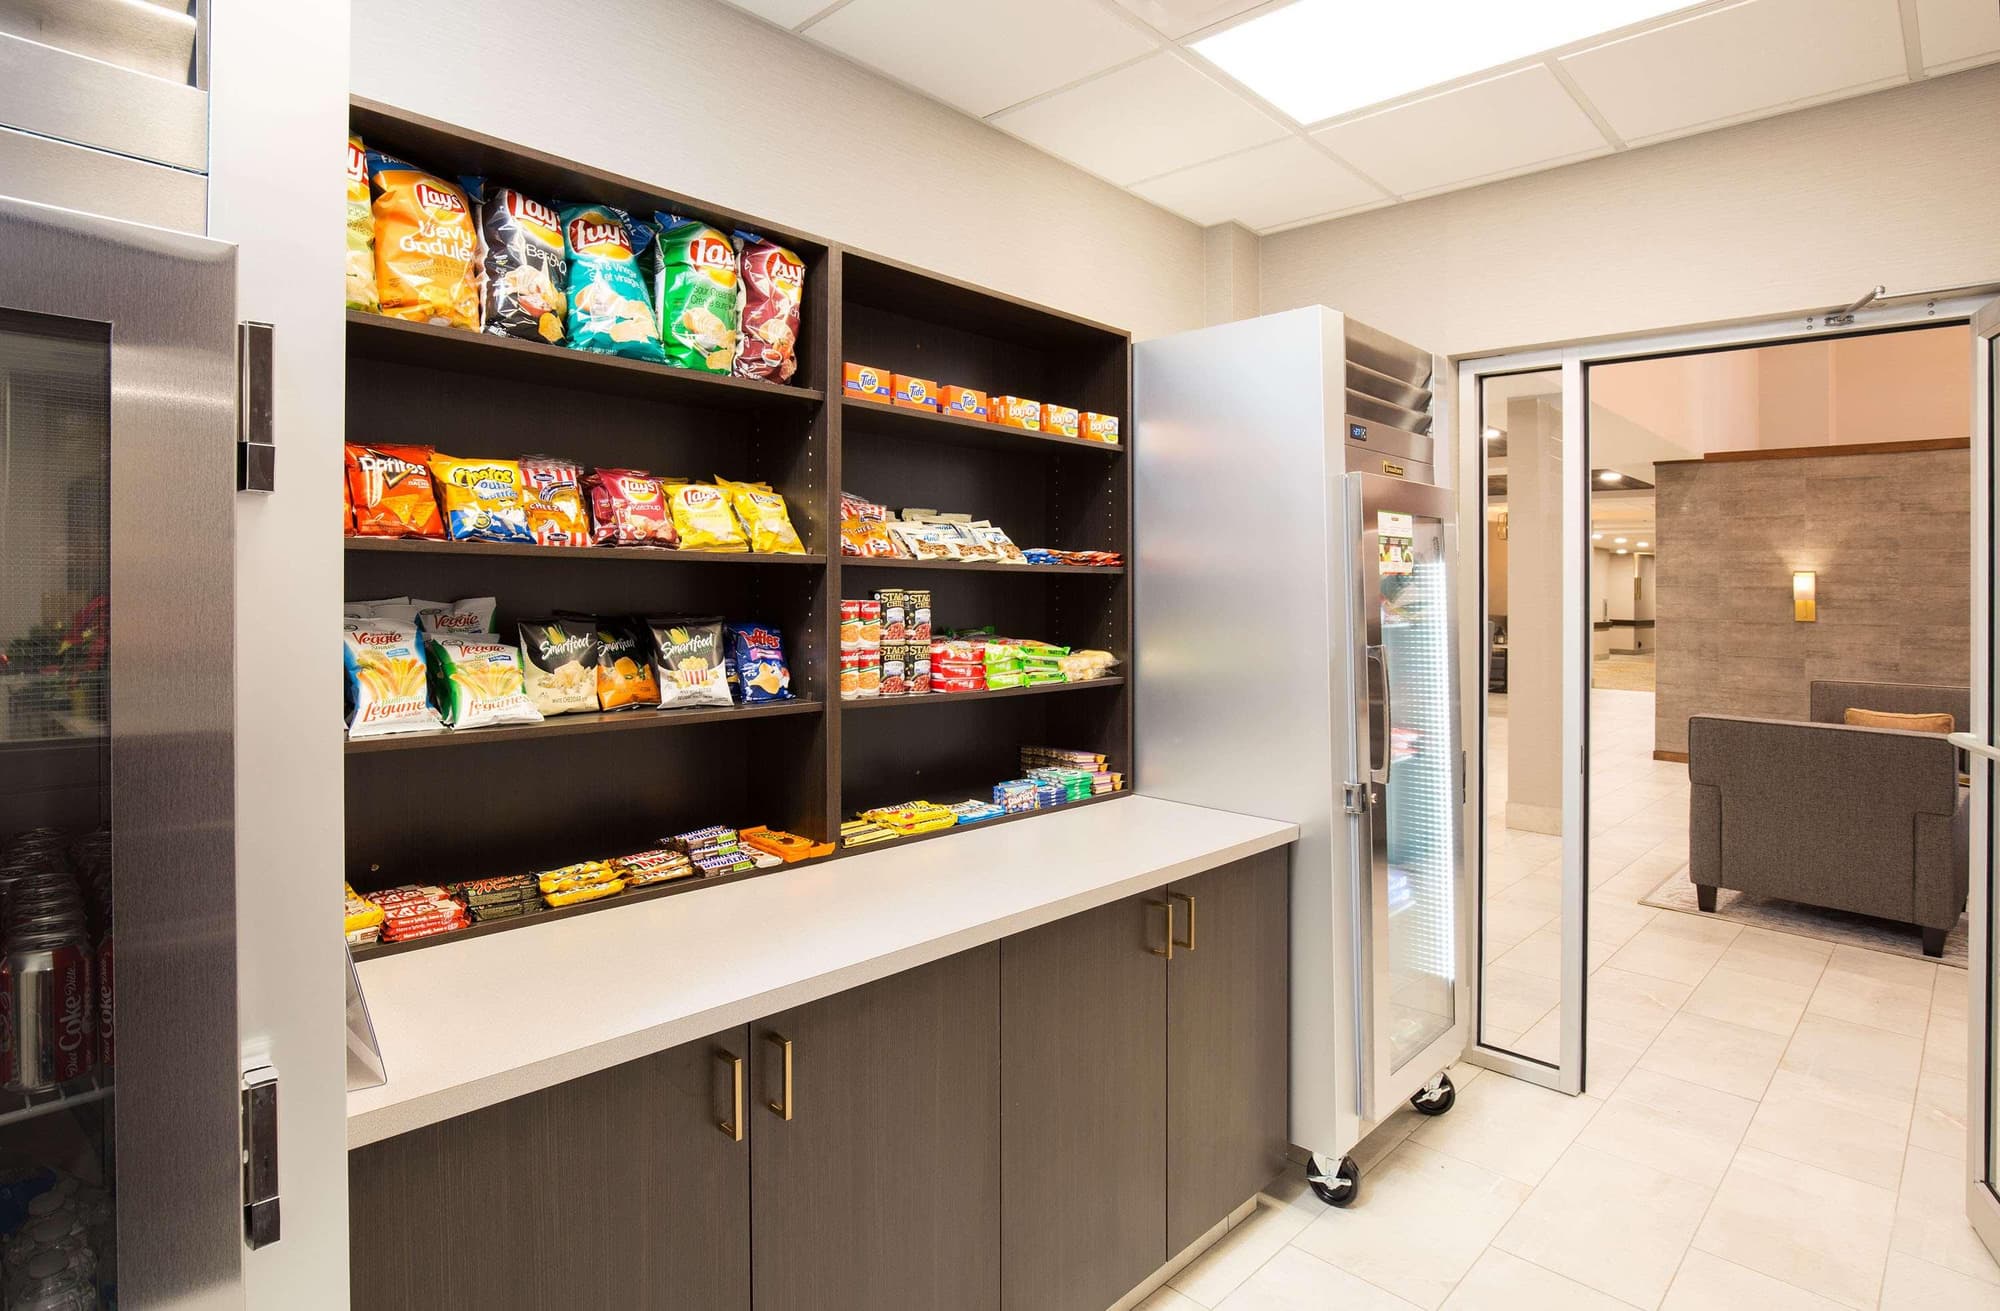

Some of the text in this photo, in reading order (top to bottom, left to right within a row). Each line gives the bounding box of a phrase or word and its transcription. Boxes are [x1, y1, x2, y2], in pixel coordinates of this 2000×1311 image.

[421, 184, 463, 211] Lay's
[400, 236, 473, 263] Ondule
[861, 373, 877, 388] Tide
[909, 384, 925, 398] Tide
[962, 395, 976, 408] Tide
[623, 479, 656, 494] Lay's
[631, 503, 661, 513] Ketchup
[434, 613, 480, 630] Veggie
[352, 631, 403, 645] Veggie
[539, 632, 591, 660] Smartfood
[660, 632, 714, 661] Smartfood
[459, 644, 505, 658] Veggie
[597, 638, 636, 657] Smartfood
[100, 985, 113, 1039] Coke
[58, 995, 82, 1052] Coke
